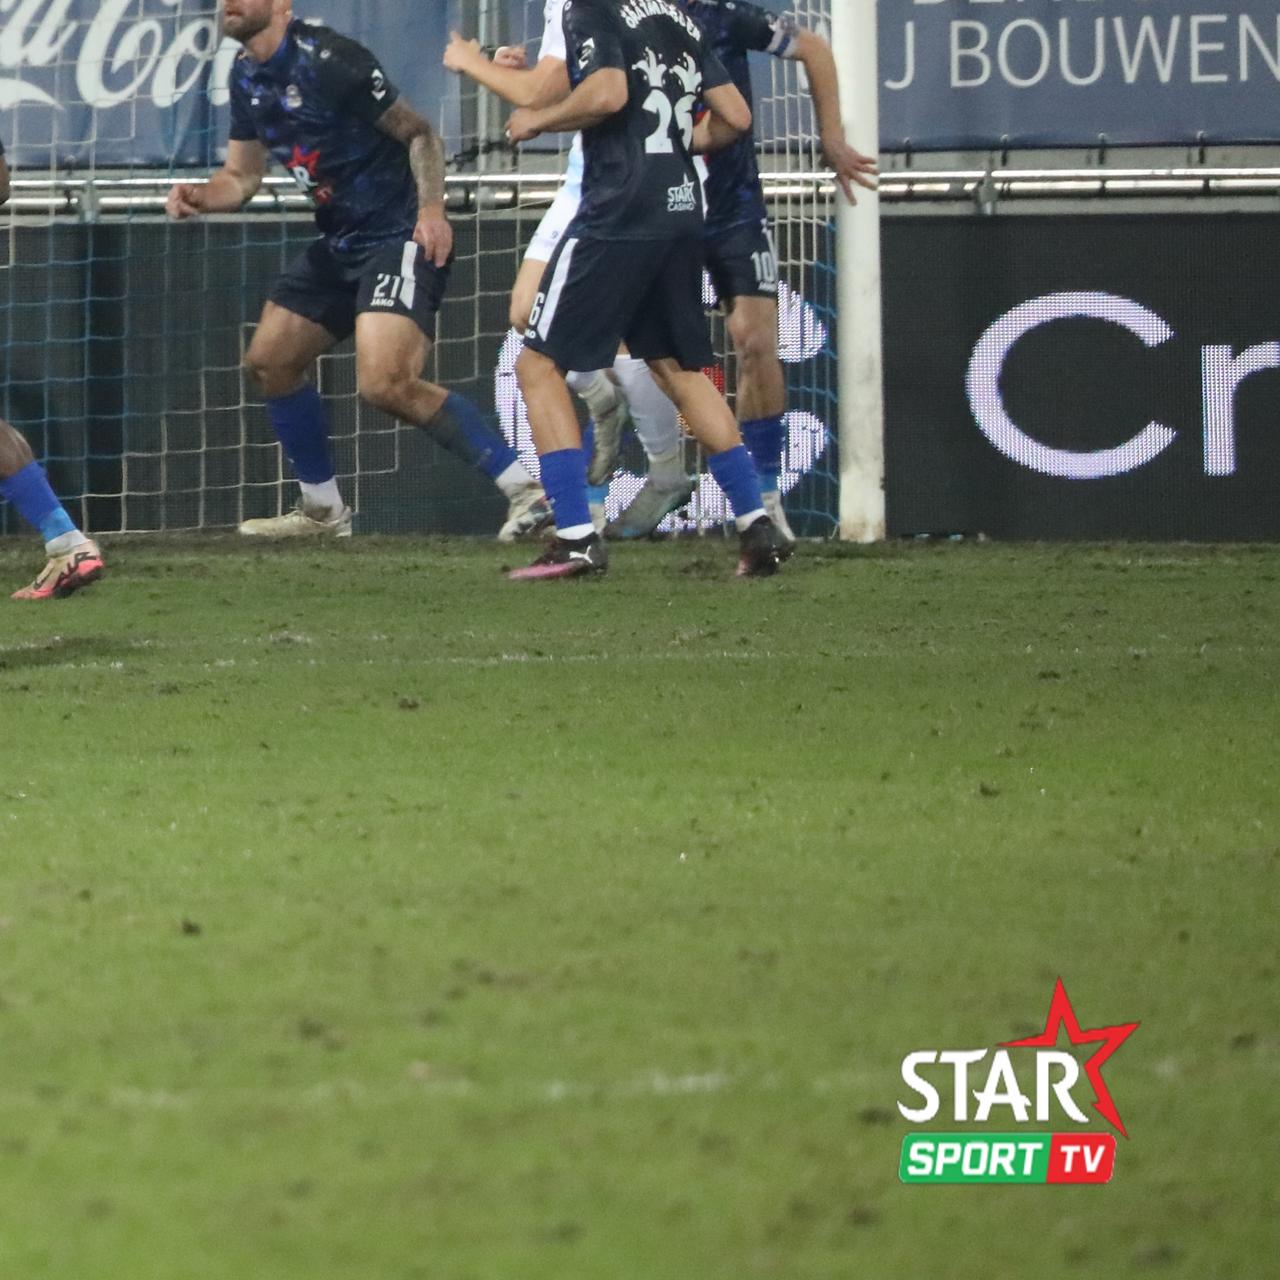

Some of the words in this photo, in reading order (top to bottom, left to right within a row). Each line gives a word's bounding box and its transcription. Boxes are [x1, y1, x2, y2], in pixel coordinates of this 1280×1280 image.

[950, 14, 1280, 89] BOUWEN
[668, 186, 694, 203] STAR
[751, 251, 776, 282] 10
[373, 273, 401, 298] 21
